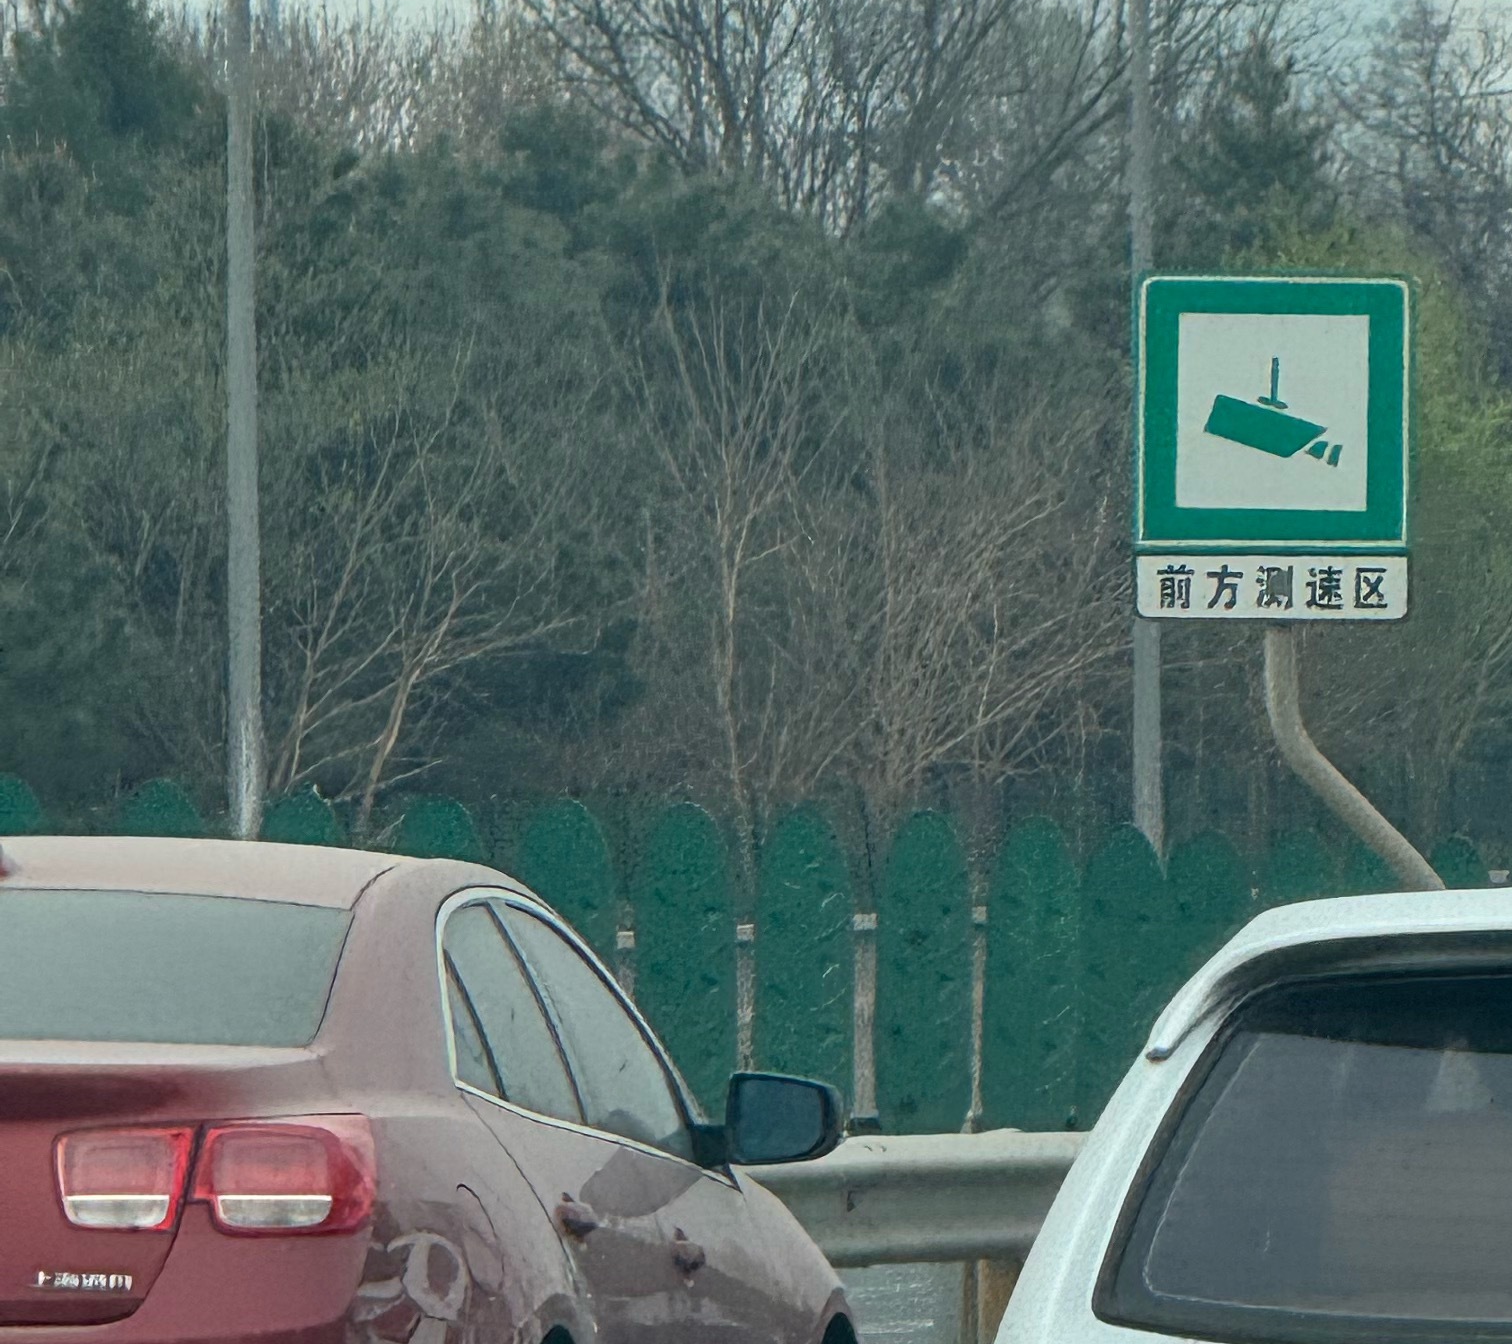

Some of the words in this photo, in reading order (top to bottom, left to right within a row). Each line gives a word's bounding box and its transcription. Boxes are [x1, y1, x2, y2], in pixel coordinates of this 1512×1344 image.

[1156, 564, 1388, 610] 前方测速区
